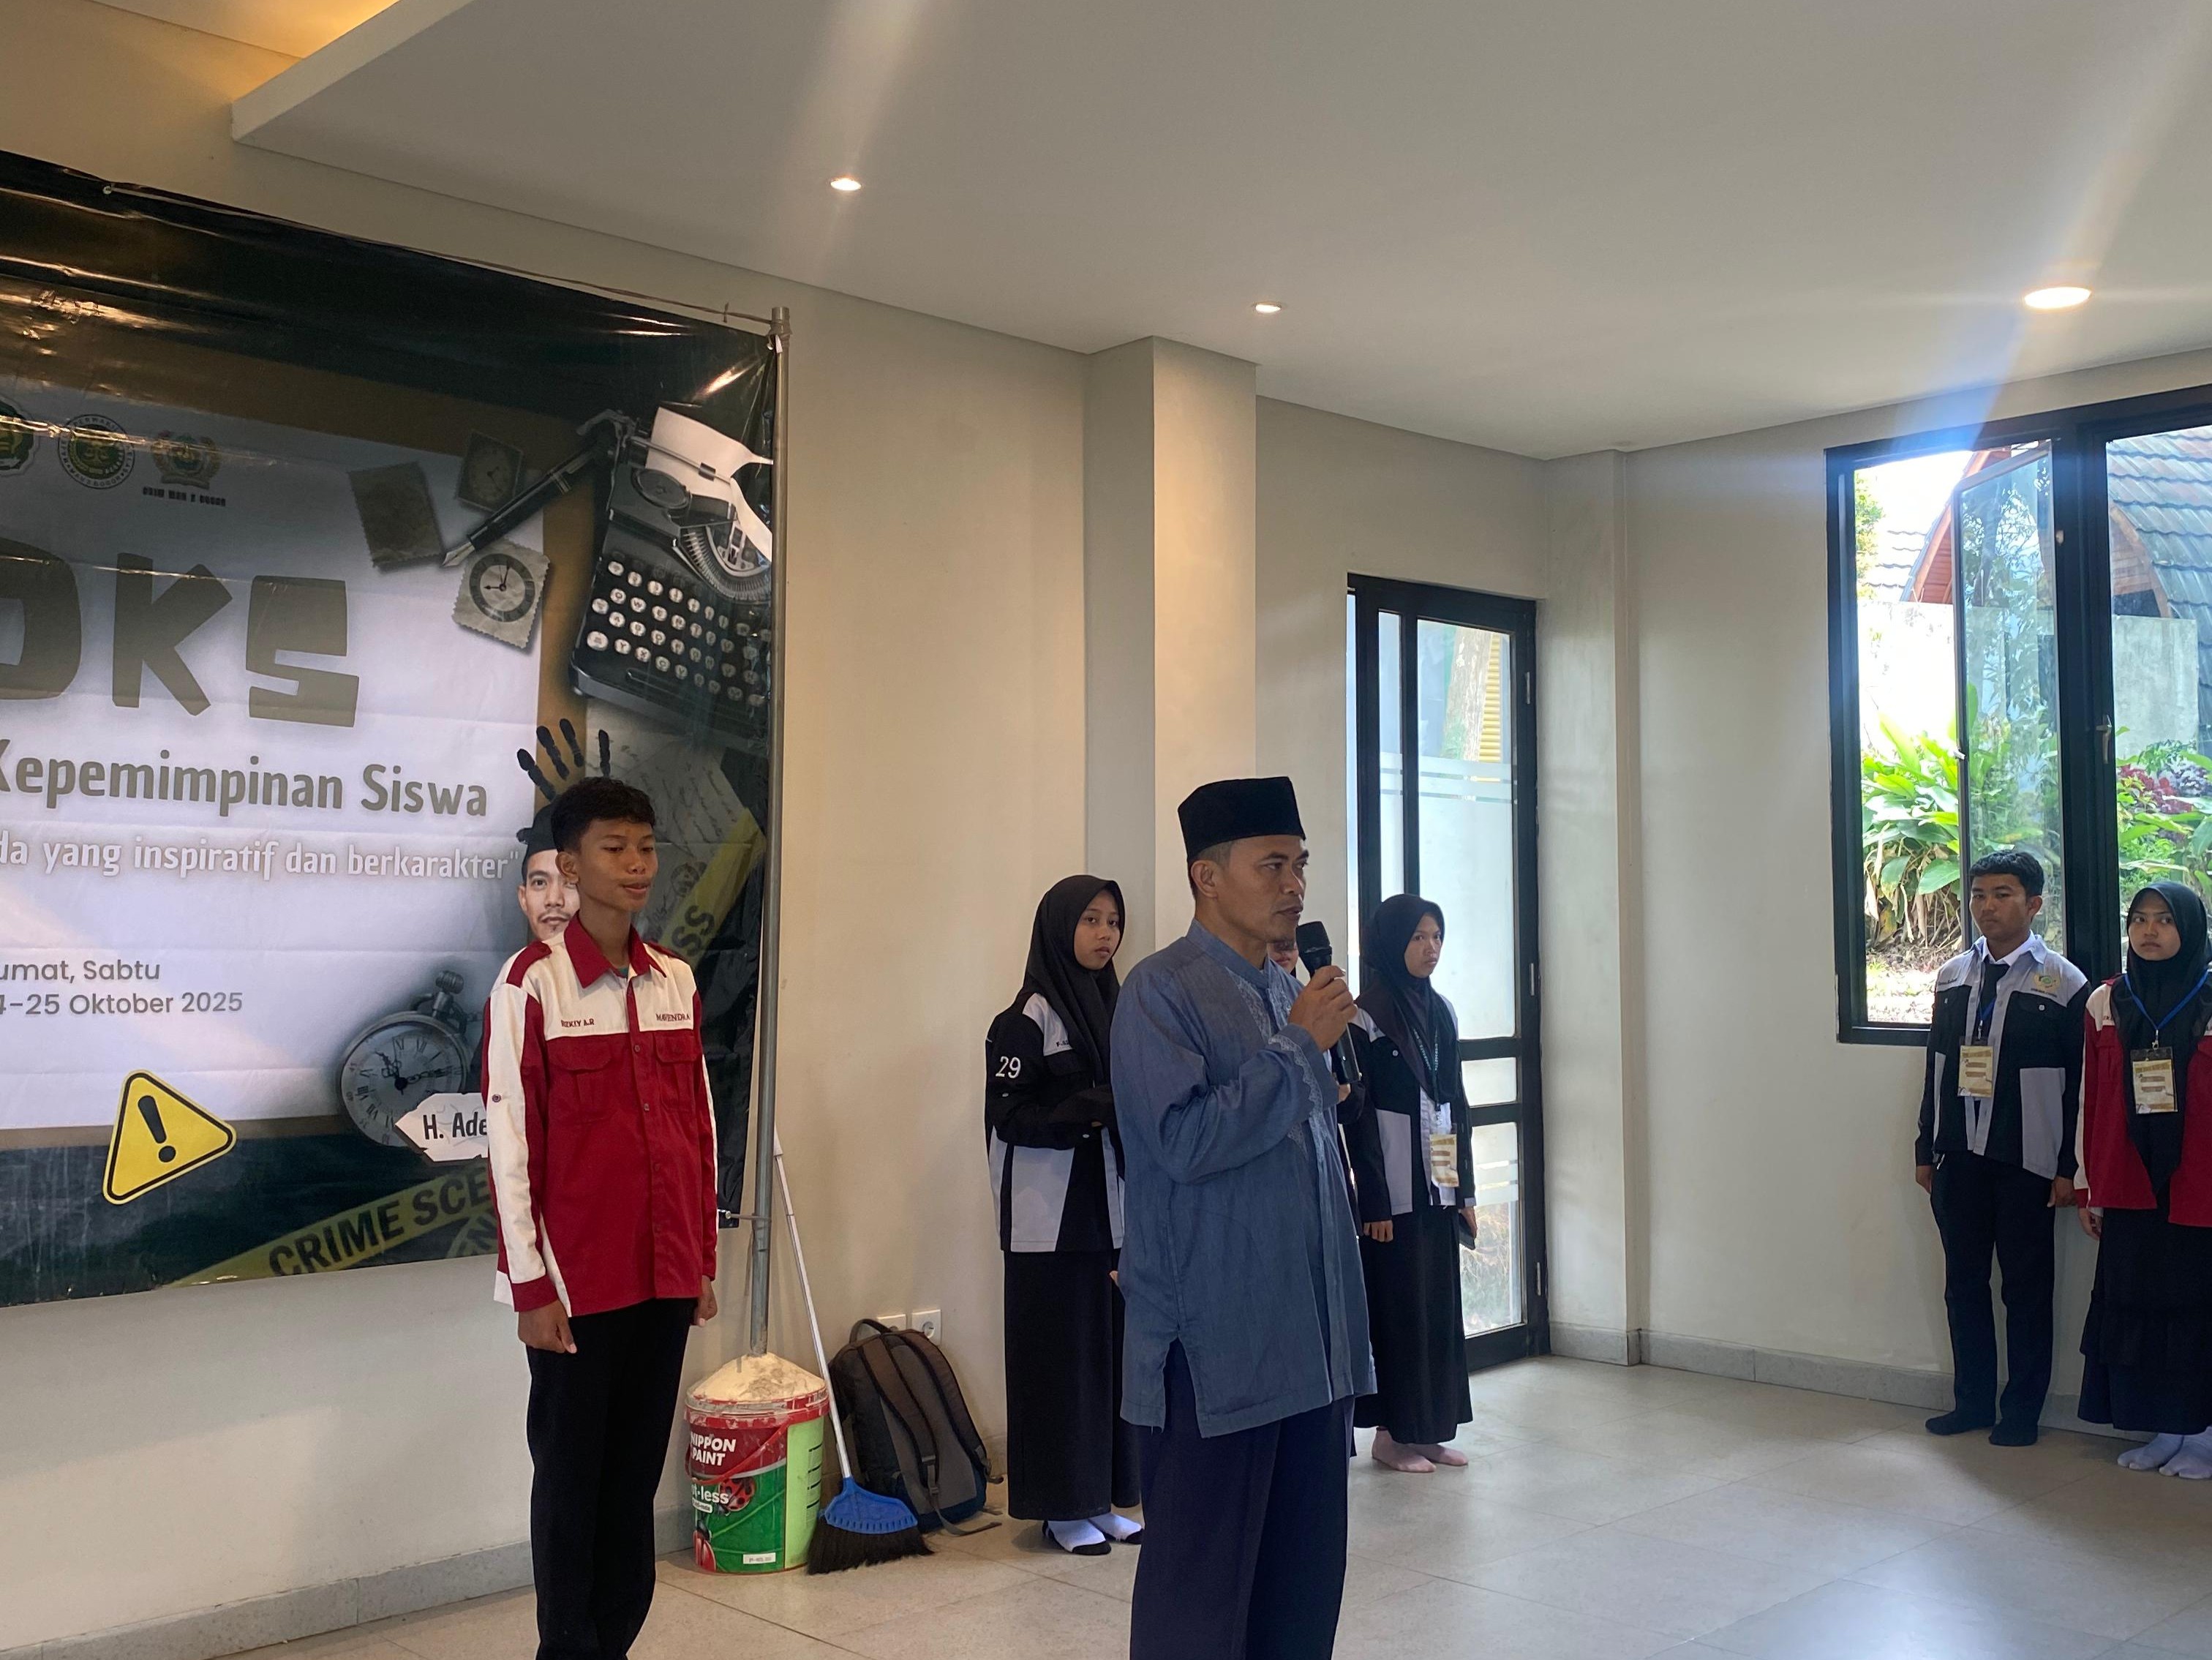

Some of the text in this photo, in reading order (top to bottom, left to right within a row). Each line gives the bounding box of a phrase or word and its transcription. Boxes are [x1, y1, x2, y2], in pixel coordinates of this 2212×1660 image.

[361, 763, 488, 817] Siswa
[43, 841, 122, 877] yang
[134, 835, 279, 882] inspiratif
[285, 842, 336, 875] dan
[347, 844, 519, 879] berkarakter"
[83, 958, 161, 980] Sabtu
[69, 992, 174, 1015] Oktober
[181, 991, 243, 1013] 2025
[995, 1055, 1022, 1079] 29
[422, 1113, 445, 1141] H.
[268, 1201, 405, 1277] CRIME
[691, 1432, 736, 1452] NIPPON
[692, 1448, 726, 1467] PAINT
